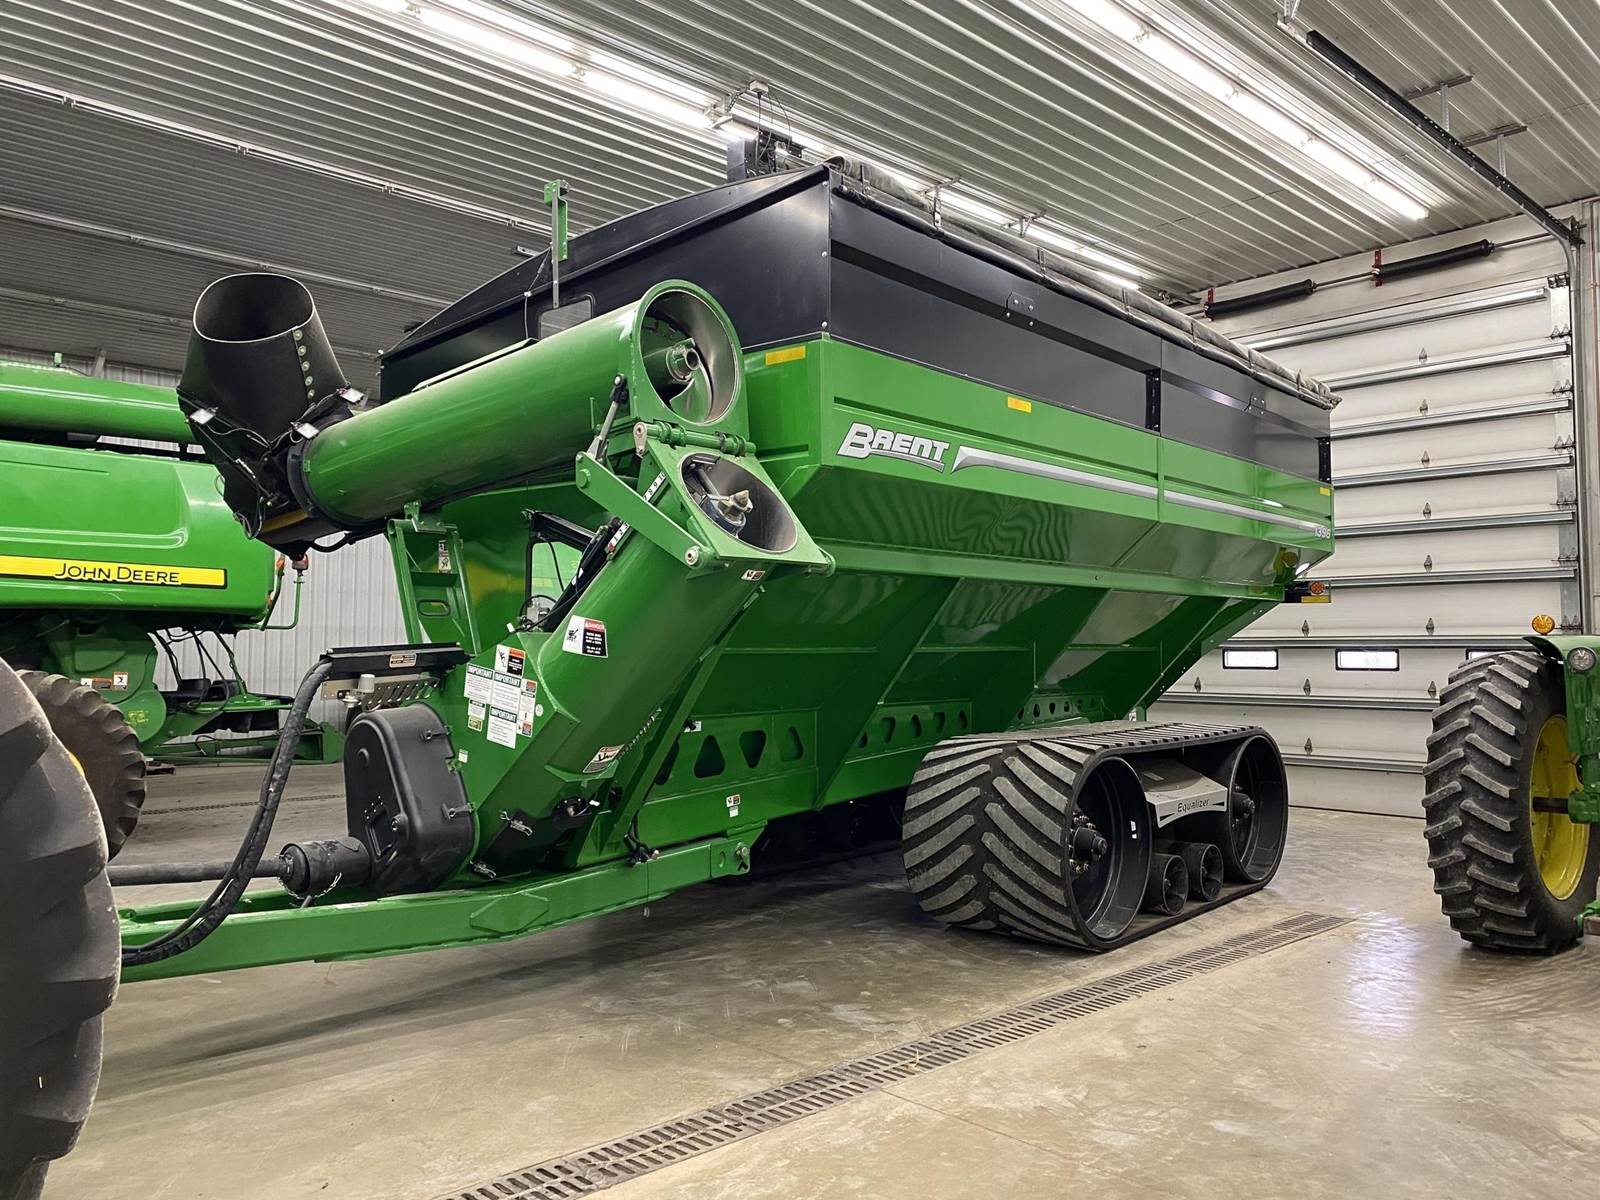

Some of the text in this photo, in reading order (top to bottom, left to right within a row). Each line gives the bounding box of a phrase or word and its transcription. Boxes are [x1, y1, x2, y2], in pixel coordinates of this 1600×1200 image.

[836, 421, 951, 463] BRENT
[55, 563, 180, 583] JOHN DEERE
[467, 665, 493, 679] IMPORTANT
[494, 673, 521, 687] IMPORTANT
[491, 707, 516, 722] IMPORTANT
[1177, 798, 1210, 813] Equalizer
